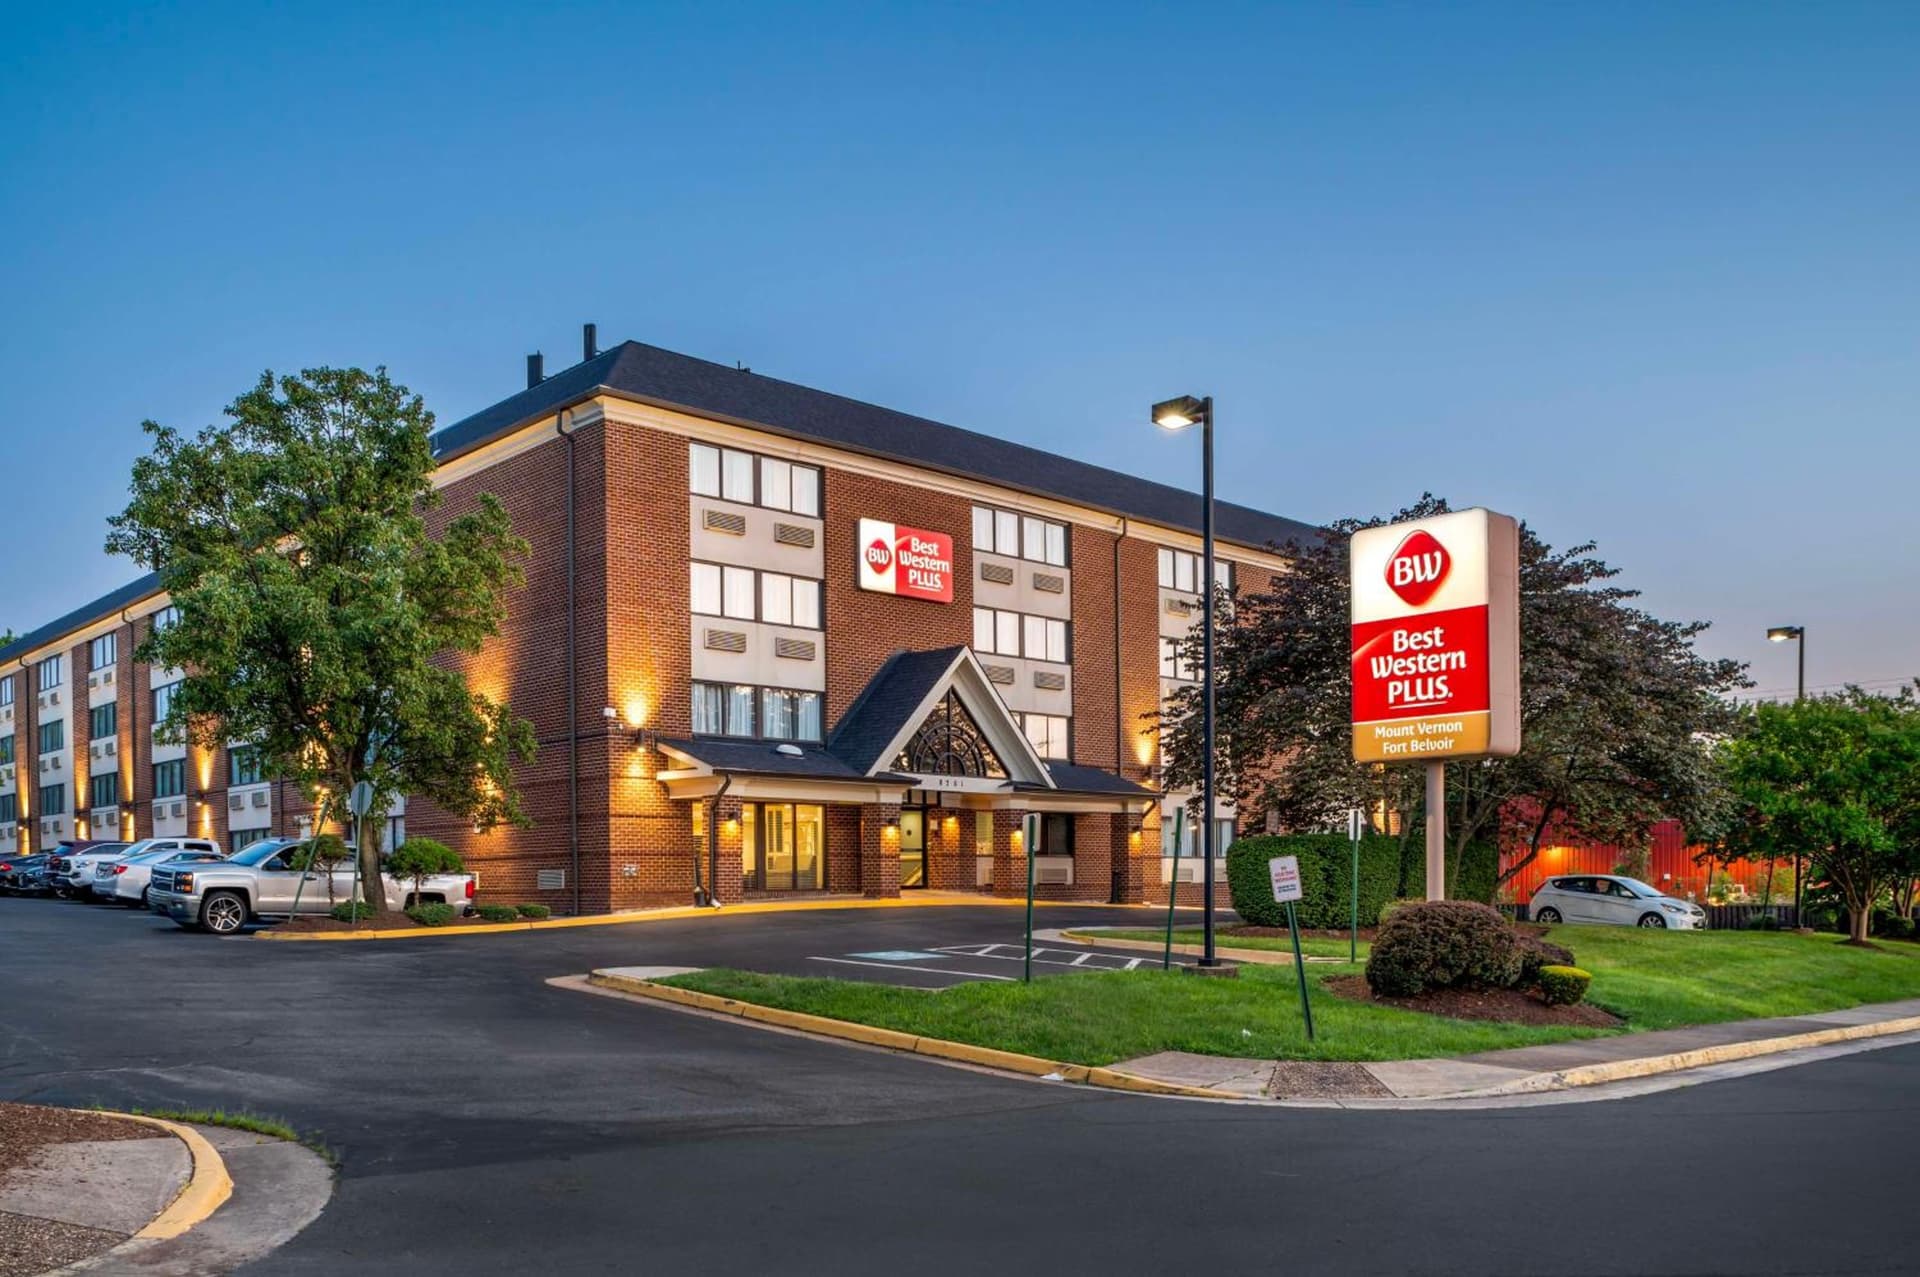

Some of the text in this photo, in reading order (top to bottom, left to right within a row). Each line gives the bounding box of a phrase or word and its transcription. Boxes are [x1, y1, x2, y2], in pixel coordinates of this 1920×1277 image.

[869, 547, 888, 565] BW
[911, 537, 939, 556] Best
[899, 550, 950, 573] Western
[1393, 551, 1442, 586] BW
[1392, 627, 1444, 653] Best
[1370, 650, 1467, 679] Western
[1374, 721, 1463, 738] Mount Vernon
[1383, 738, 1455, 755] Fort Belvoir
